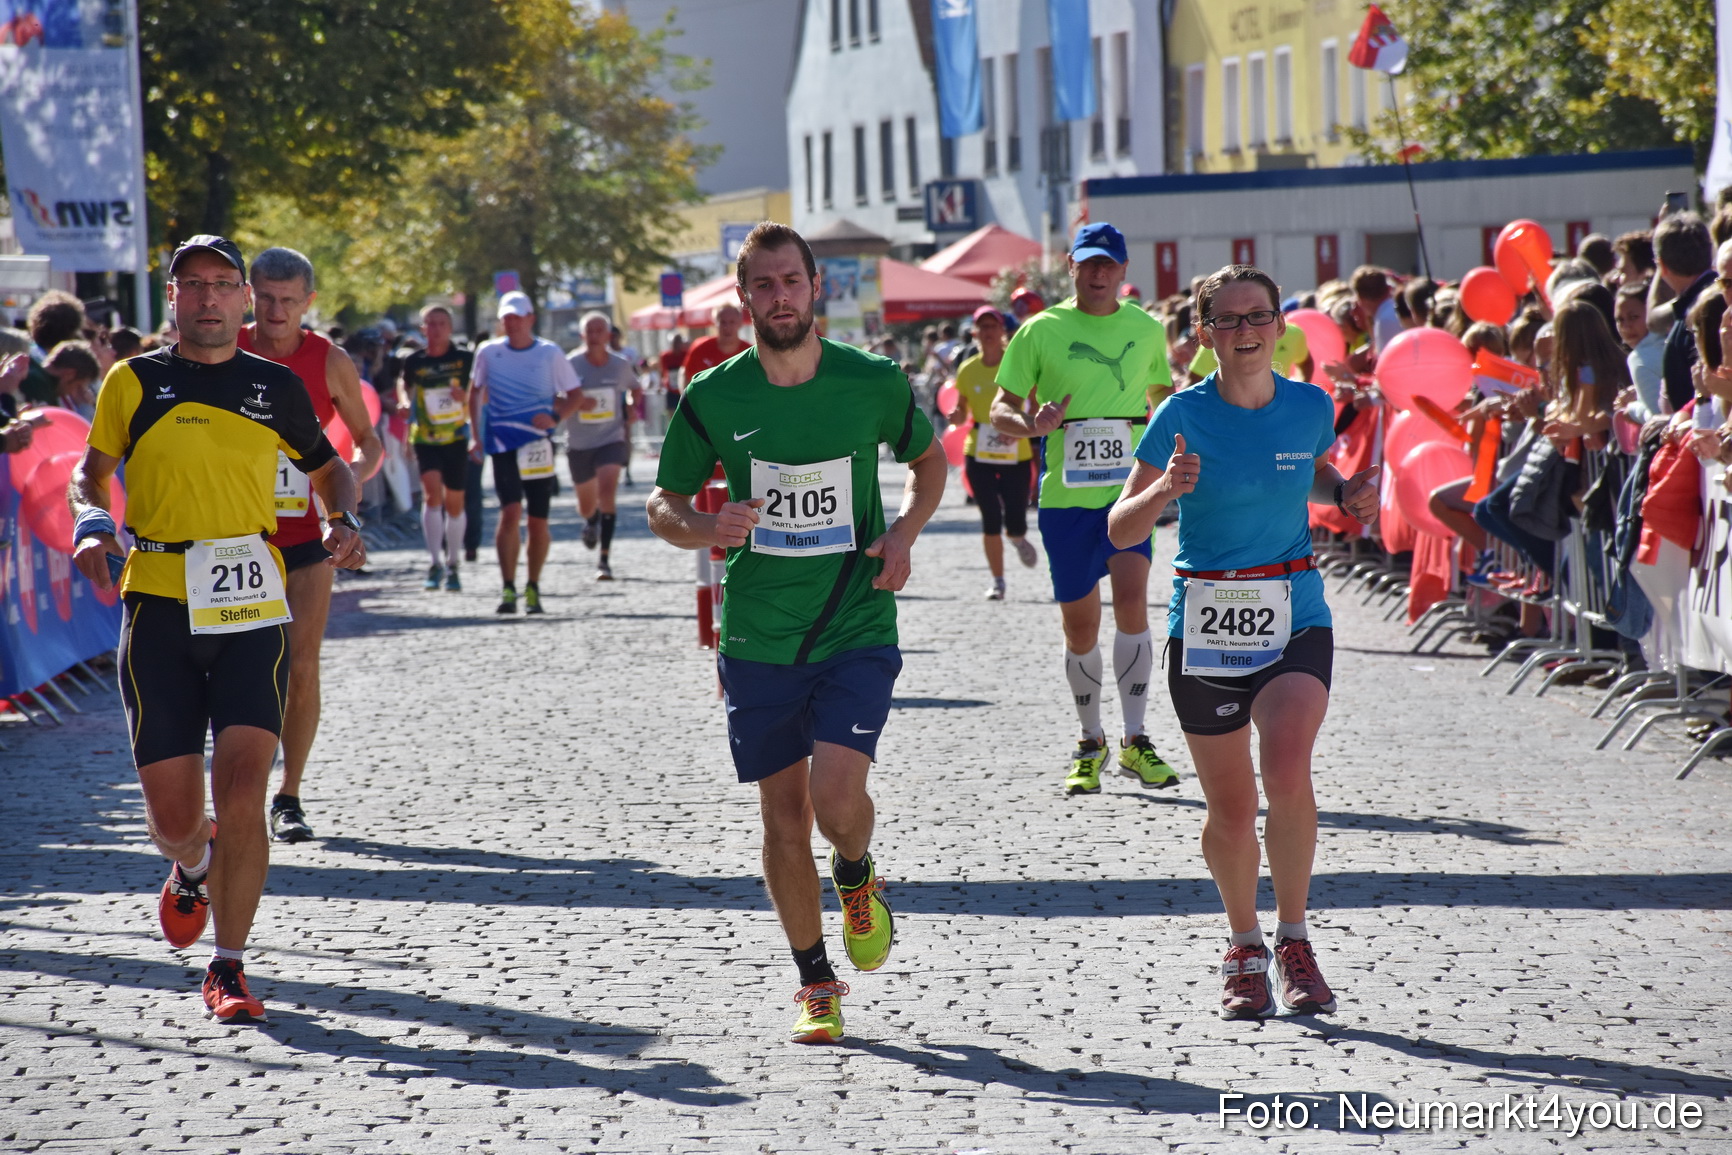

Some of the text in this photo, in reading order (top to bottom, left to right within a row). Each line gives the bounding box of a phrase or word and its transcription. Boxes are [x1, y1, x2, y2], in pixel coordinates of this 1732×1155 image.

[156, 392, 176, 400] erima
[239, 406, 273, 420] Burgthann
[175, 416, 210, 425] Steffen
[1083, 427, 1114, 435] BOCK
[1074, 439, 1123, 461] 2138
[780, 470, 822, 485] BOCK
[1088, 471, 1111, 481] Horst
[766, 486, 837, 518] 2105
[772, 520, 824, 529] PARTL Neumarkt
[785, 534, 819, 547] Manu
[215, 544, 252, 557] BOCK
[211, 561, 263, 593] 218
[233, 593, 259, 602] Neumarkt
[1215, 589, 1261, 600] BOCK
[220, 607, 261, 622] Steffen
[1200, 607, 1275, 637] 2482
[1221, 653, 1253, 666] Irene
